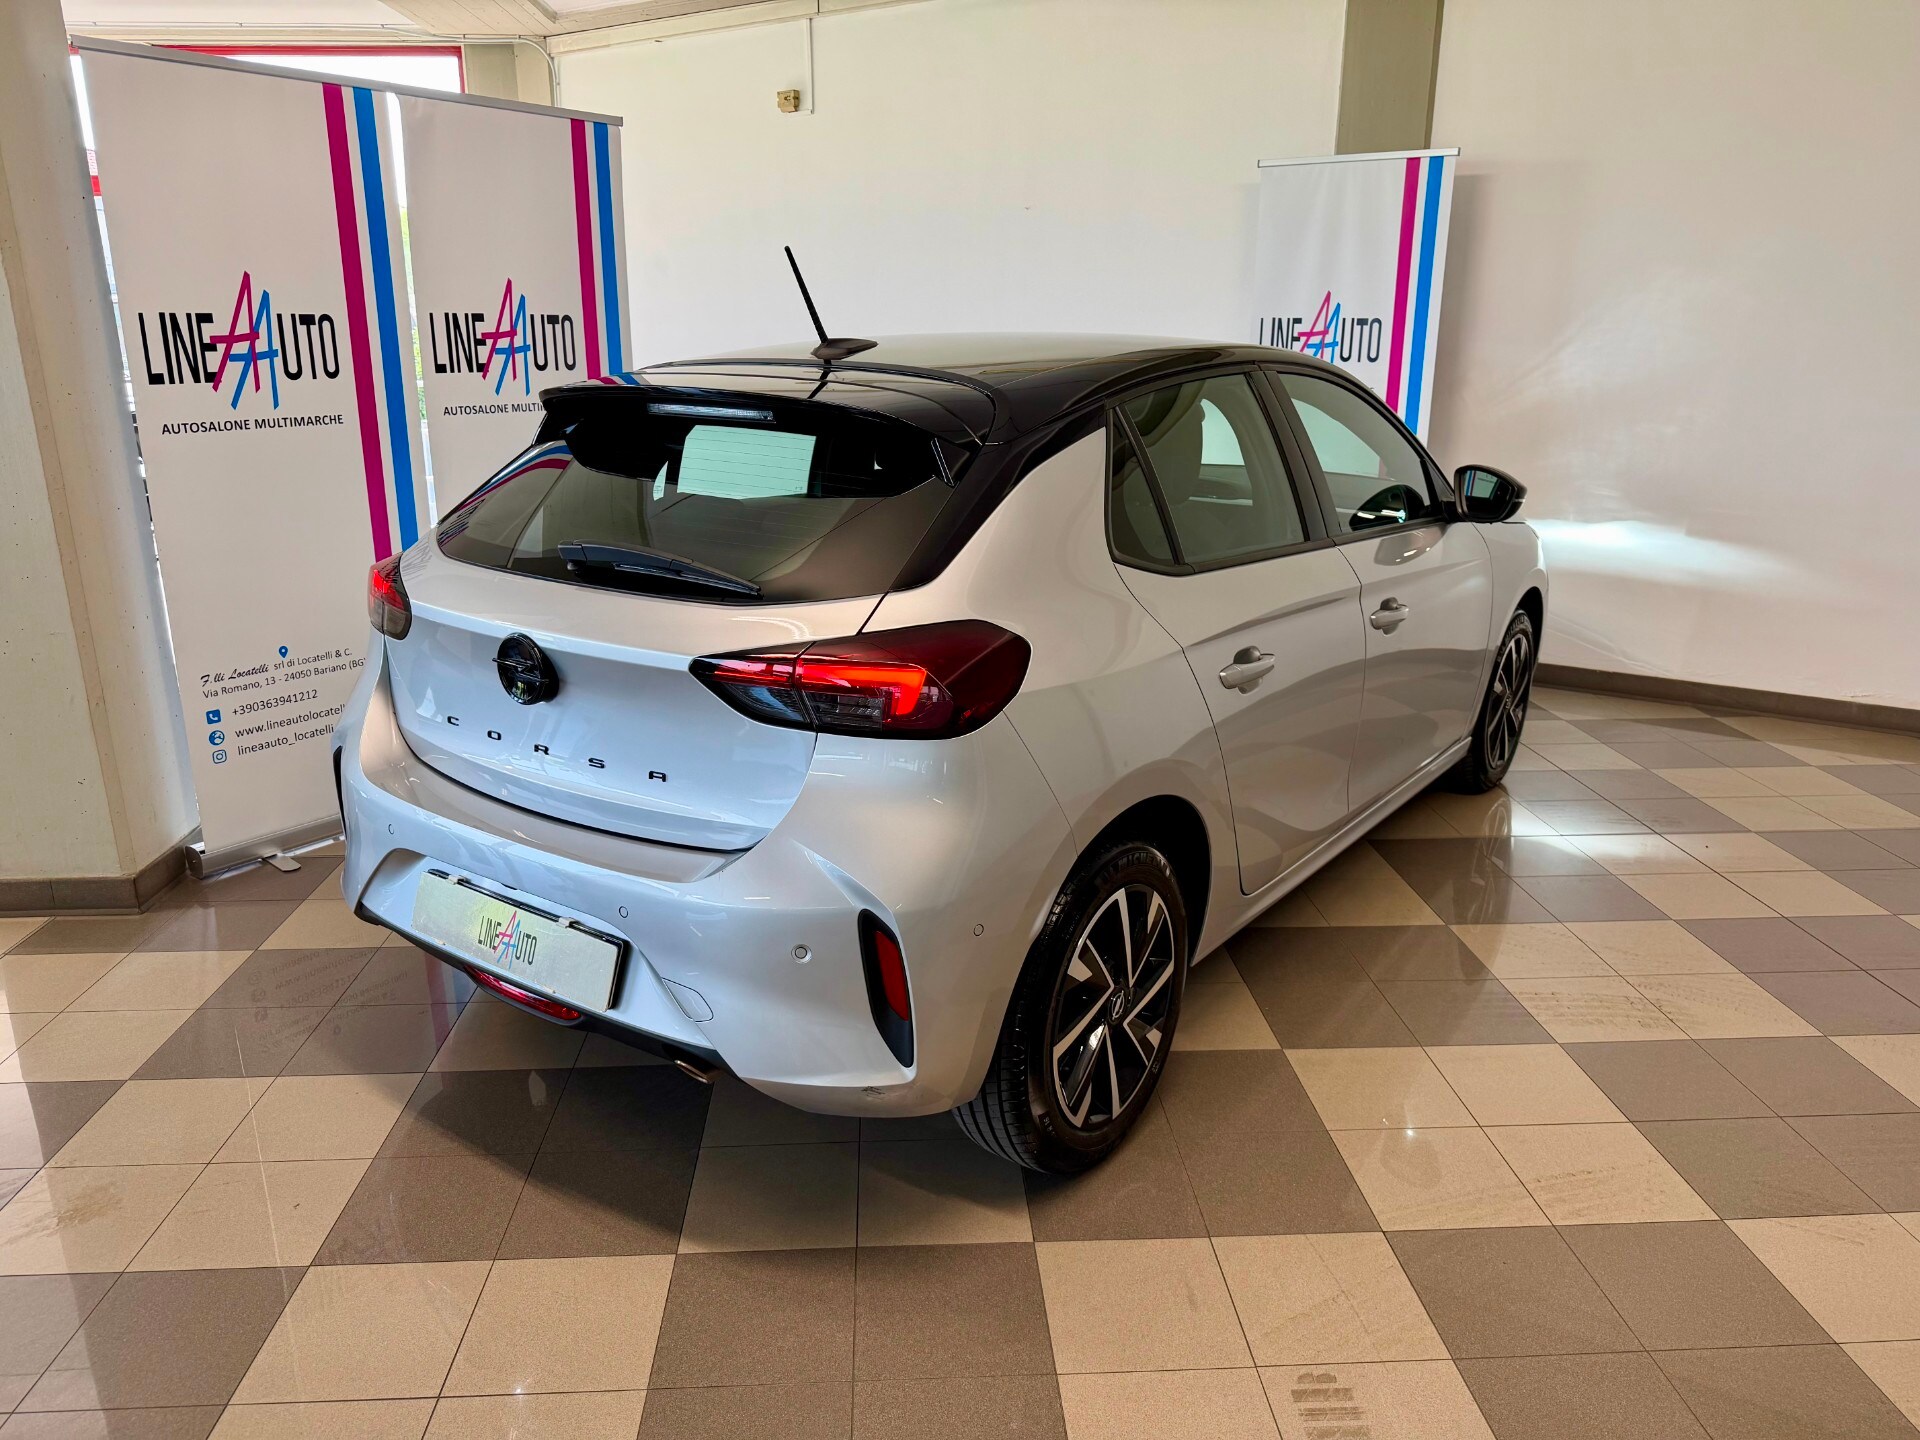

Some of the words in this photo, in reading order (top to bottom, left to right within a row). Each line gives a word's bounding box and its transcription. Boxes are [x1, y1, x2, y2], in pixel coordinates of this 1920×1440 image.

[162, 419, 250, 435] AUTOSALONE
[254, 414, 344, 430] MULTIMARCHE
[443, 403, 509, 416] AUTOSALONE
[228, 664, 269, 680] Locatelli
[273, 660, 285, 670] srl
[286, 658, 295, 668] di
[297, 651, 333, 666] Locatelli
[335, 649, 342, 658] &
[344, 647, 352, 656] C.
[202, 689, 219, 699] Via
[221, 681, 263, 696] Romano,
[265, 676, 276, 686] 13
[284, 669, 312, 682] 24050
[314, 663, 347, 676] Bariano
[232, 689, 318, 716] +390363941212
[237, 723, 335, 756] lineaauto_locatelli
[447, 715, 667, 783] CORSA
